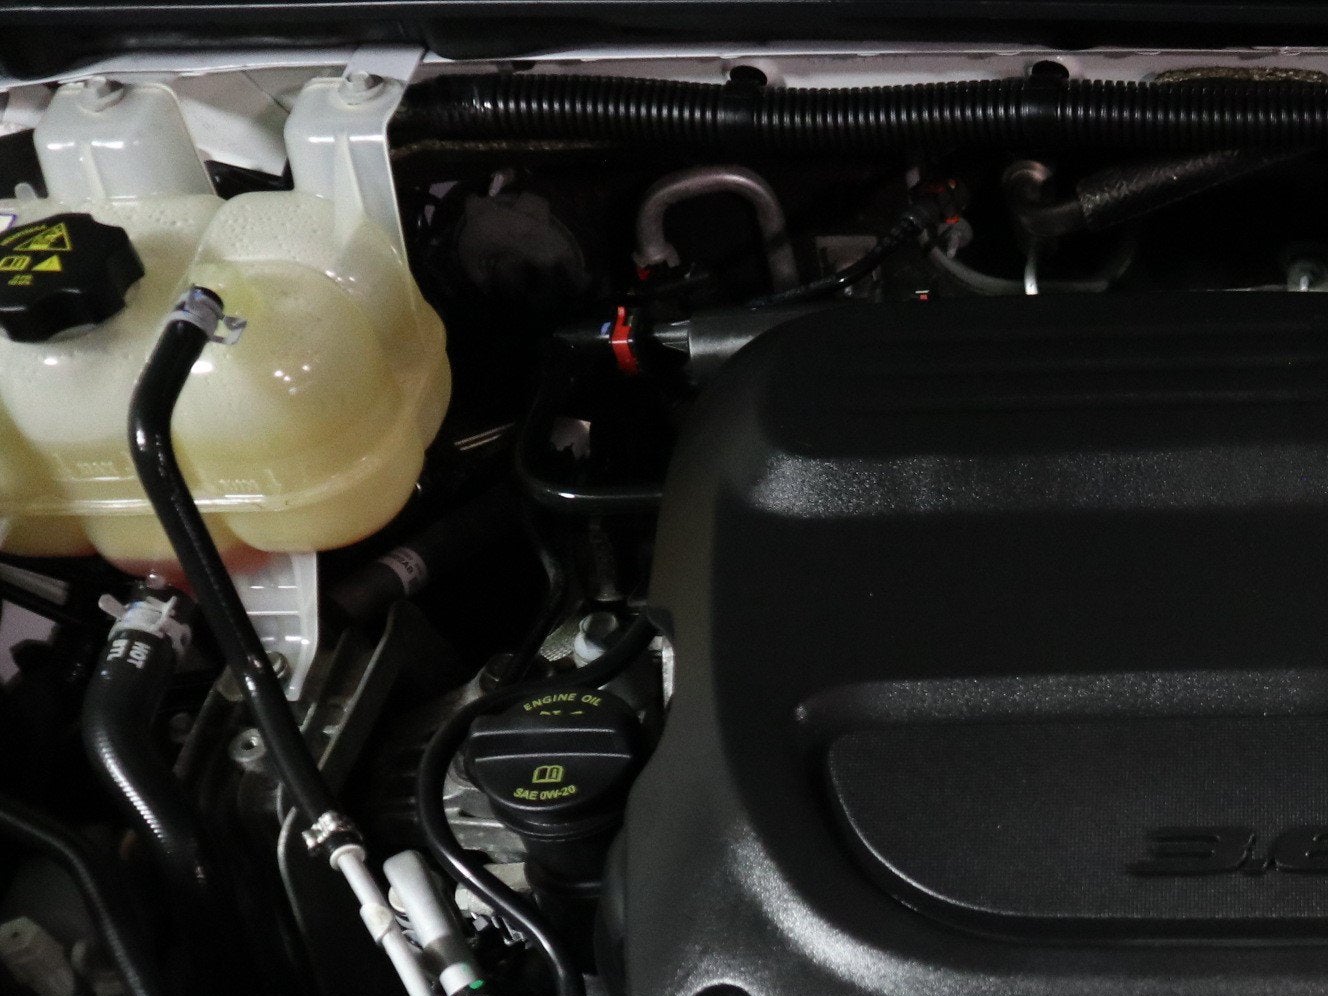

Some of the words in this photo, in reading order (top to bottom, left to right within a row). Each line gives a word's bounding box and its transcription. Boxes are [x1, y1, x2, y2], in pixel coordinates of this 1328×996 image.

[523, 693, 577, 711] ENGINE
[581, 694, 602, 706] OIL
[513, 787, 539, 800] SAE
[539, 784, 577, 800] 0W-20
